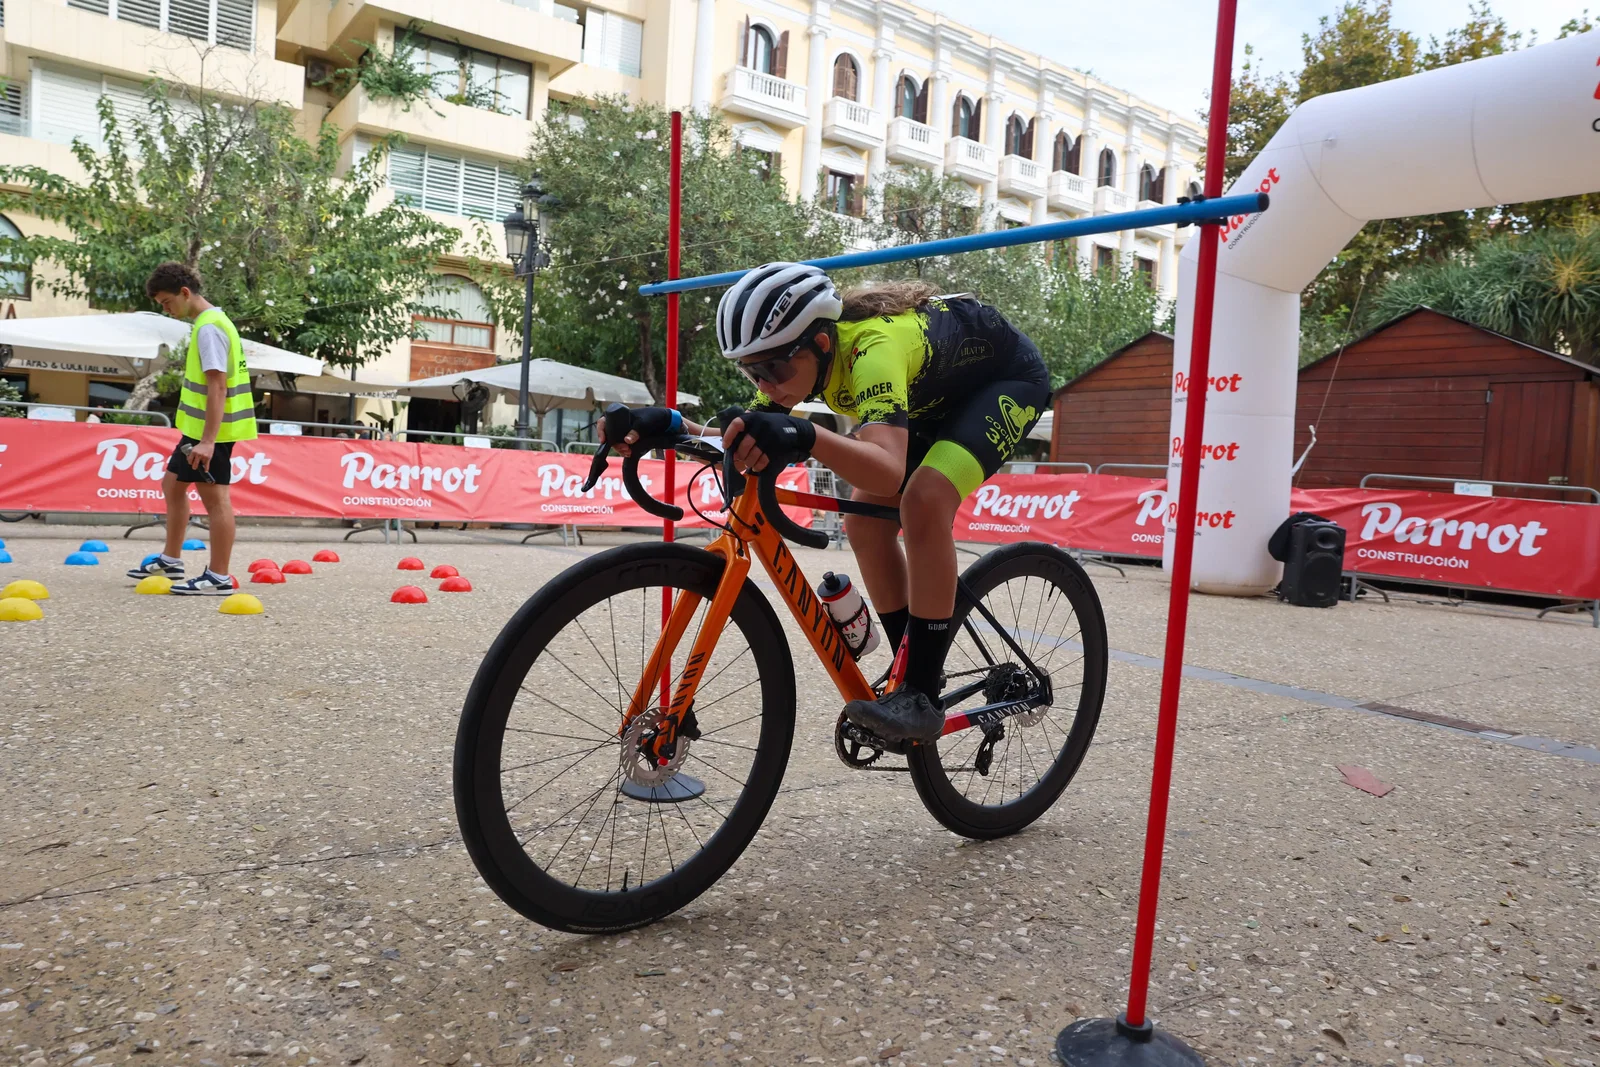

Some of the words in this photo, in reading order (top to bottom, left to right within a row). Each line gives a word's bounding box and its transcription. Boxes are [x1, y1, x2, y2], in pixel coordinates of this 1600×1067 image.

[1220, 167, 1280, 243] Paot
[764, 288, 793, 331] MET
[1174, 371, 1242, 393] Parot
[96, 438, 272, 485] Paot
[1172, 436, 1240, 461] Prot
[340, 451, 482, 493] Parrot
[342, 496, 432, 507] CONSTRUCCIÓN
[540, 503, 614, 514] CONSTRUCCIÓN
[973, 484, 1081, 520] Parrot
[968, 522, 1030, 533] CONSTRUCCIÓN
[1168, 502, 1236, 529] Prot
[1360, 502, 1548, 557] Parrot
[1357, 548, 1469, 569] CONSTRUCCIÓN
[773, 540, 846, 672] CANYON
[977, 701, 1031, 724] CANYON
